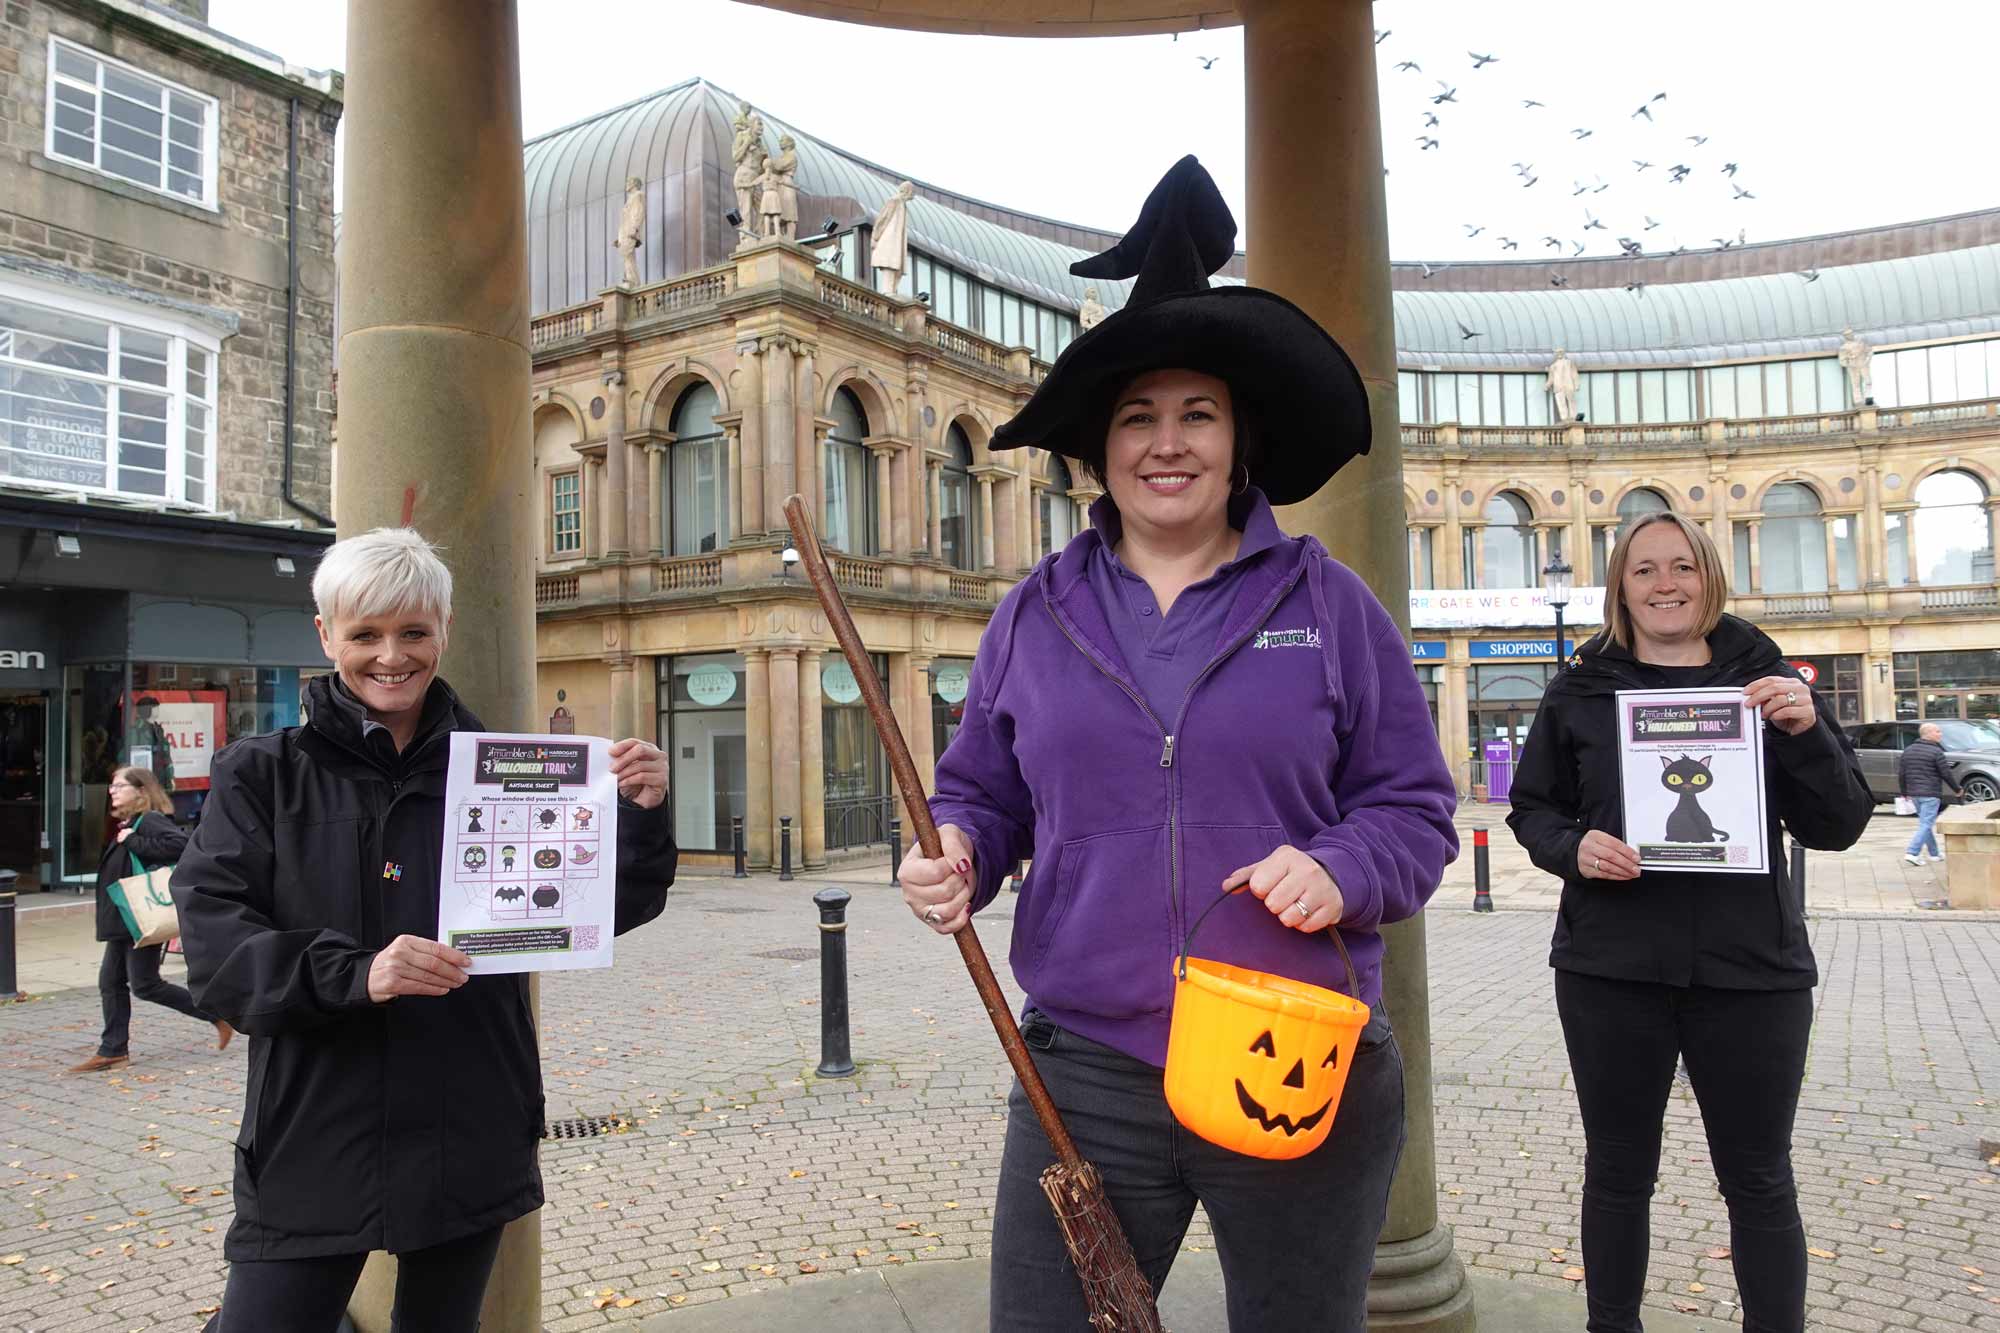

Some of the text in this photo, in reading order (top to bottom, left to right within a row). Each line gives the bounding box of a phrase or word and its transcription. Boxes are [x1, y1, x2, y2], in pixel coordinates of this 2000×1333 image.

[26, 416, 102, 436] OUTDOOR
[50, 431, 102, 448] TRAVEL
[26, 440, 102, 461] CLOTHING
[25, 463, 102, 484] SINCE 1972
[1490, 642, 1552, 655] SHOPPING
[0, 650, 45, 669] an
[1648, 720, 1722, 732] HALLOWEEN TRAIL
[166, 732, 204, 748] ALE
[493, 762, 567, 774] HALLOWEEN TRAIL
